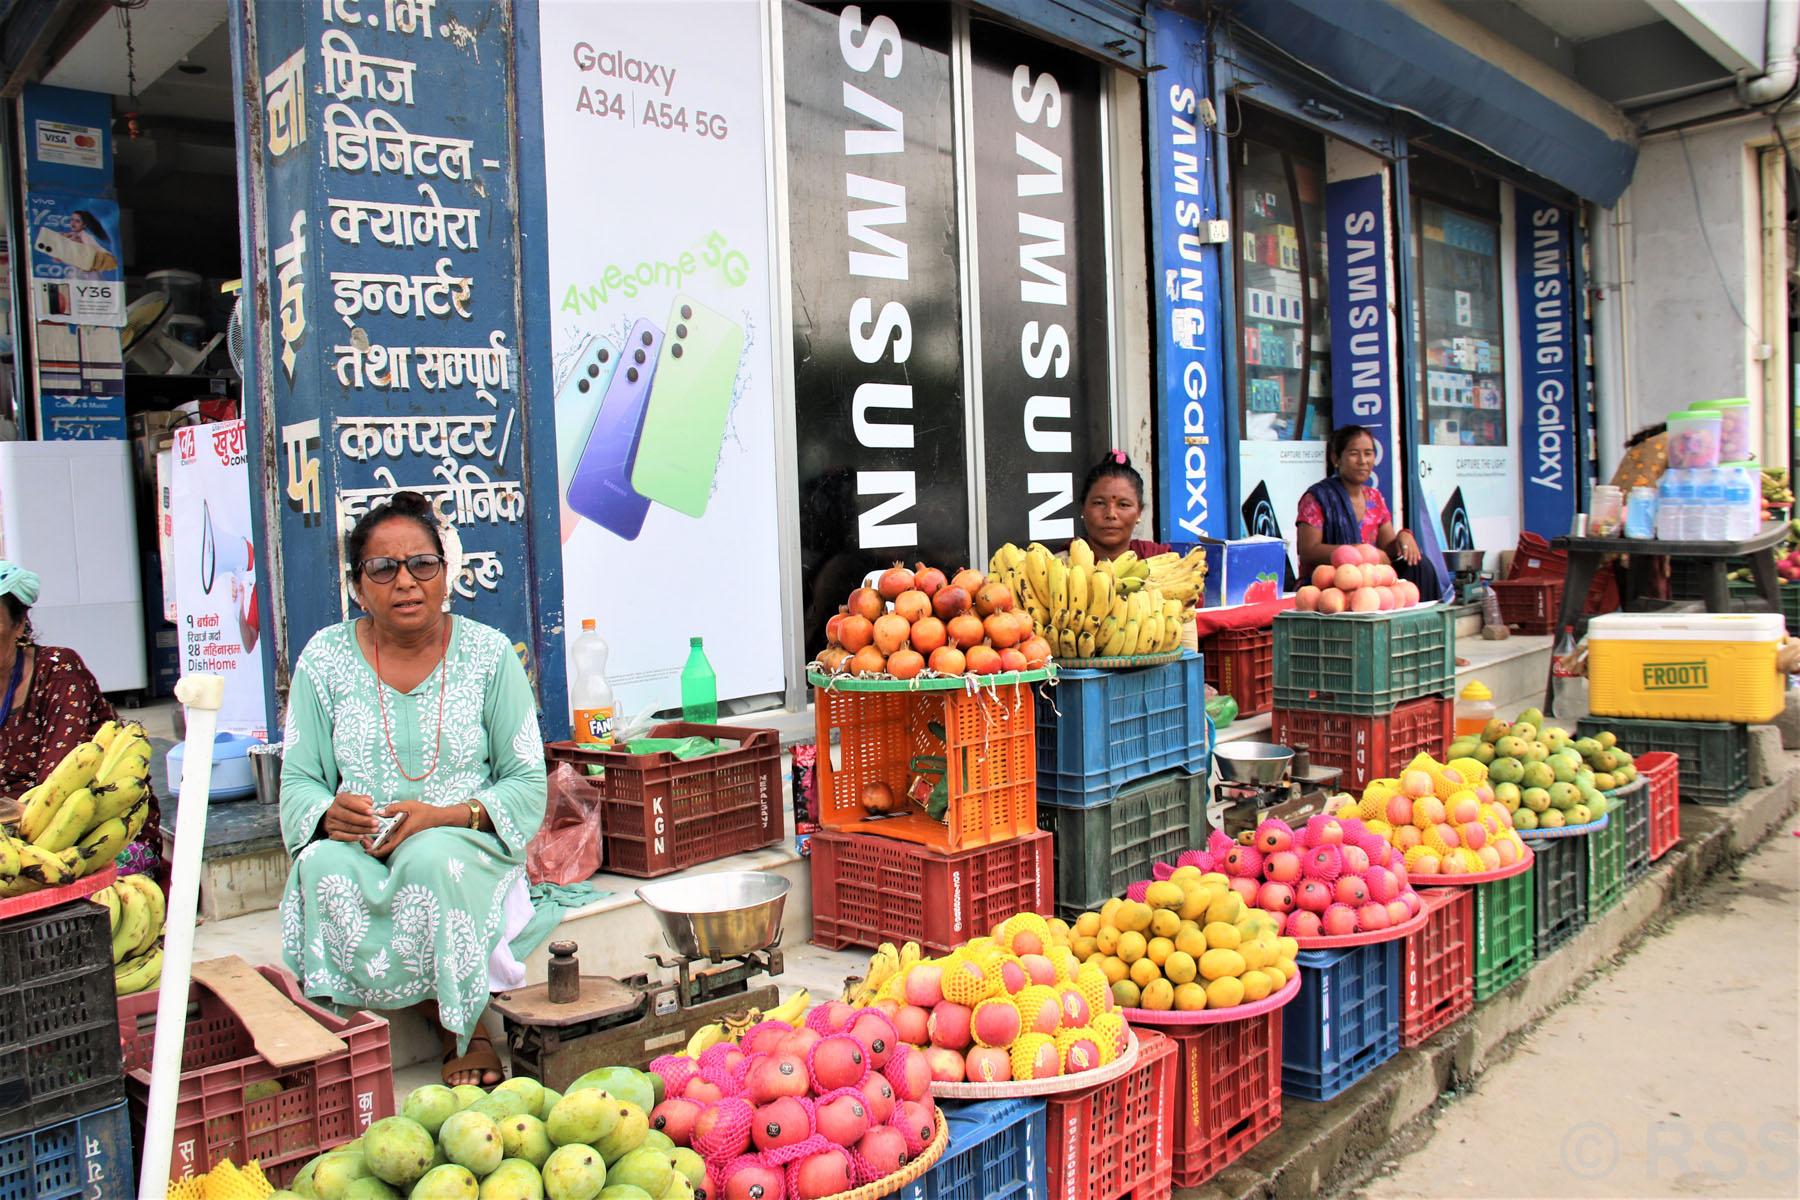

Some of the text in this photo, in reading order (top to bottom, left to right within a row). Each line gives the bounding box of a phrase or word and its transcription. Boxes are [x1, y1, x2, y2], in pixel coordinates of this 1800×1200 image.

[321, 29, 416, 105] फ्रिज
[573, 41, 676, 96] Galaxy
[44, 133, 67, 144] VISA
[575, 86, 728, 140] A34 A54 5G
[328, 183, 481, 250] क्यामेरा
[77, 286, 112, 299] Y36
[560, 229, 750, 316] Awesome 5G
[838, 5, 918, 590] SAMSUN
[1012, 64, 1075, 541] SAMSUN
[1344, 210, 1383, 416] SAMSUNG
[1531, 208, 1564, 491] SAMSUNG Galaxy
[230, 454, 248, 466] CON
[188, 644, 200, 656] २४
[189, 658, 236, 671] DishHome
[1643, 666, 1708, 686] FROOTI
[589, 717, 614, 735] FAN
[652, 796, 666, 855] KGN
